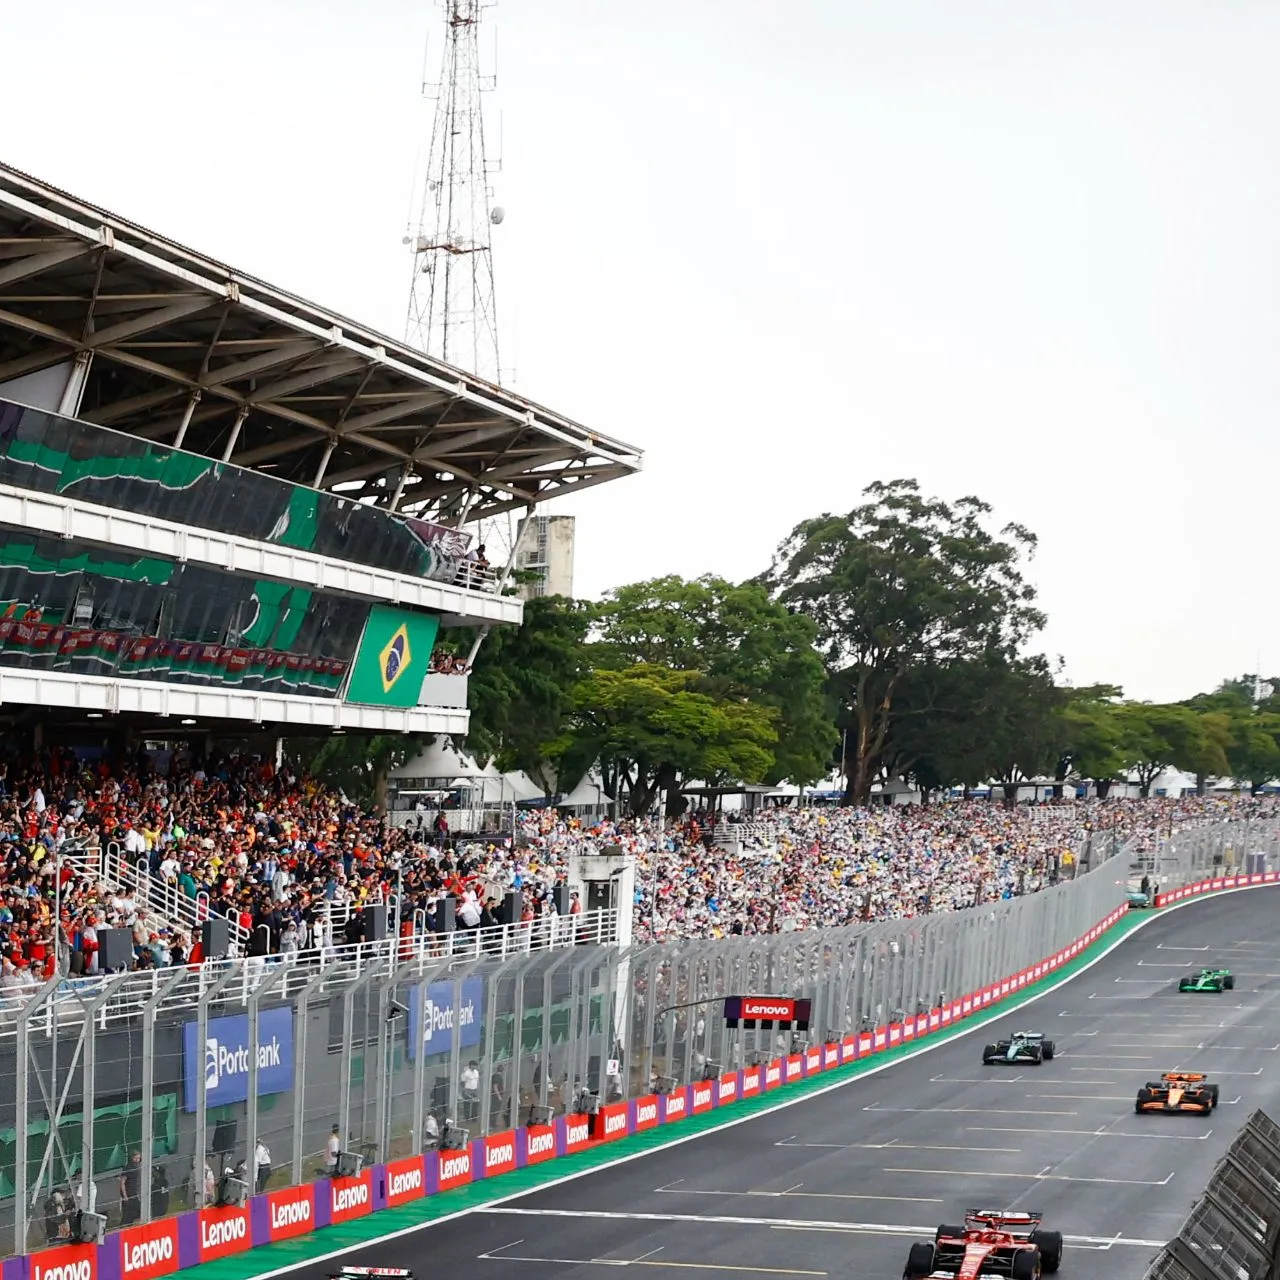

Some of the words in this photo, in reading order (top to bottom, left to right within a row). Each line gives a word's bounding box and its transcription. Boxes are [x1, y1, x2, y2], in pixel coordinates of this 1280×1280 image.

[745, 1003, 789, 1015] Lenovo
[667, 1097, 684, 1114] Lenovo
[694, 1089, 710, 1106] Lenovo
[606, 1114, 625, 1133] Lenovo
[637, 1105, 656, 1123] Lenovo
[528, 1133, 553, 1155] Lenovo
[567, 1124, 588, 1144] Lenovo
[440, 1156, 469, 1178] Lenovo
[486, 1145, 512, 1167] Lenovo
[389, 1170, 421, 1196] Lenovo
[333, 1184, 367, 1212] Lenovo
[272, 1200, 310, 1228] Lenovo
[202, 1217, 245, 1248] Lenovo
[125, 1237, 172, 1272] Lenovo
